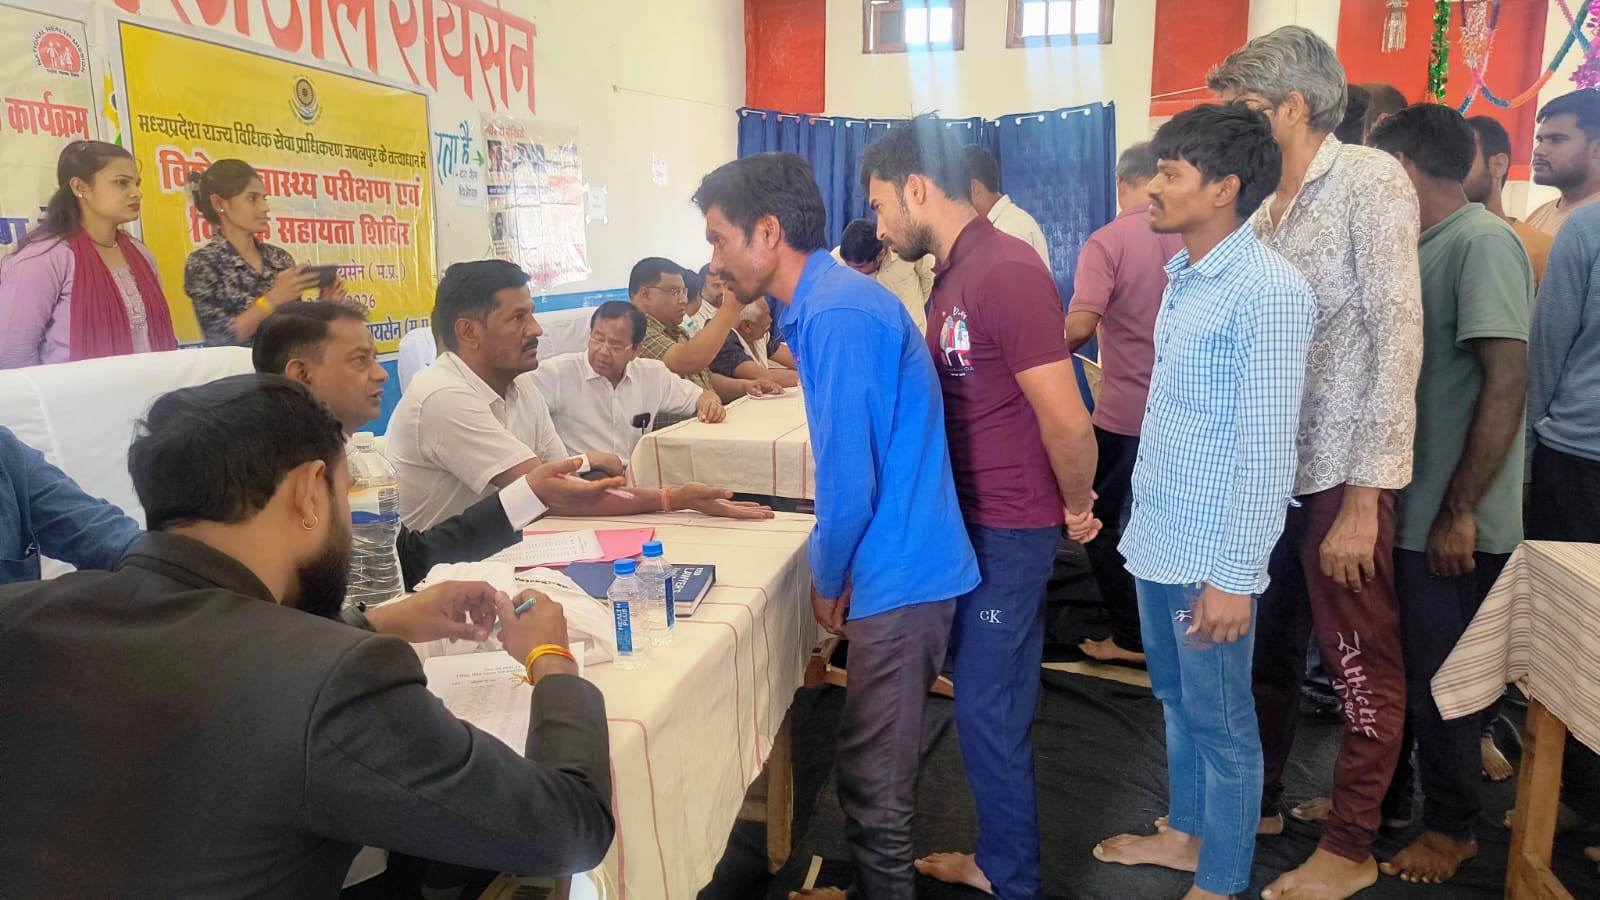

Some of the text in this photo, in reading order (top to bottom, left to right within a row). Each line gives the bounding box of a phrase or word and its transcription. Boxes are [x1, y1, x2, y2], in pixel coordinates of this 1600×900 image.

[5, 91, 90, 140] कार्यक्रम
[138, 112, 200, 140] मध्यप्रदेश
[202, 123, 233, 144] राज्य
[233, 121, 272, 148] विधिक
[273, 128, 295, 151] सेवा
[295, 132, 344, 158] प्राधिकरण
[344, 144, 378, 168] जबलपुर
[378, 144, 388, 164] के
[323, 169, 392, 205] परीक्षण
[395, 176, 420, 207] एवं
[276, 217, 355, 245] सहायता
[359, 213, 410, 245] शिविर
[979, 609, 1003, 624] CK
[1336, 630, 1379, 738] Athletic
